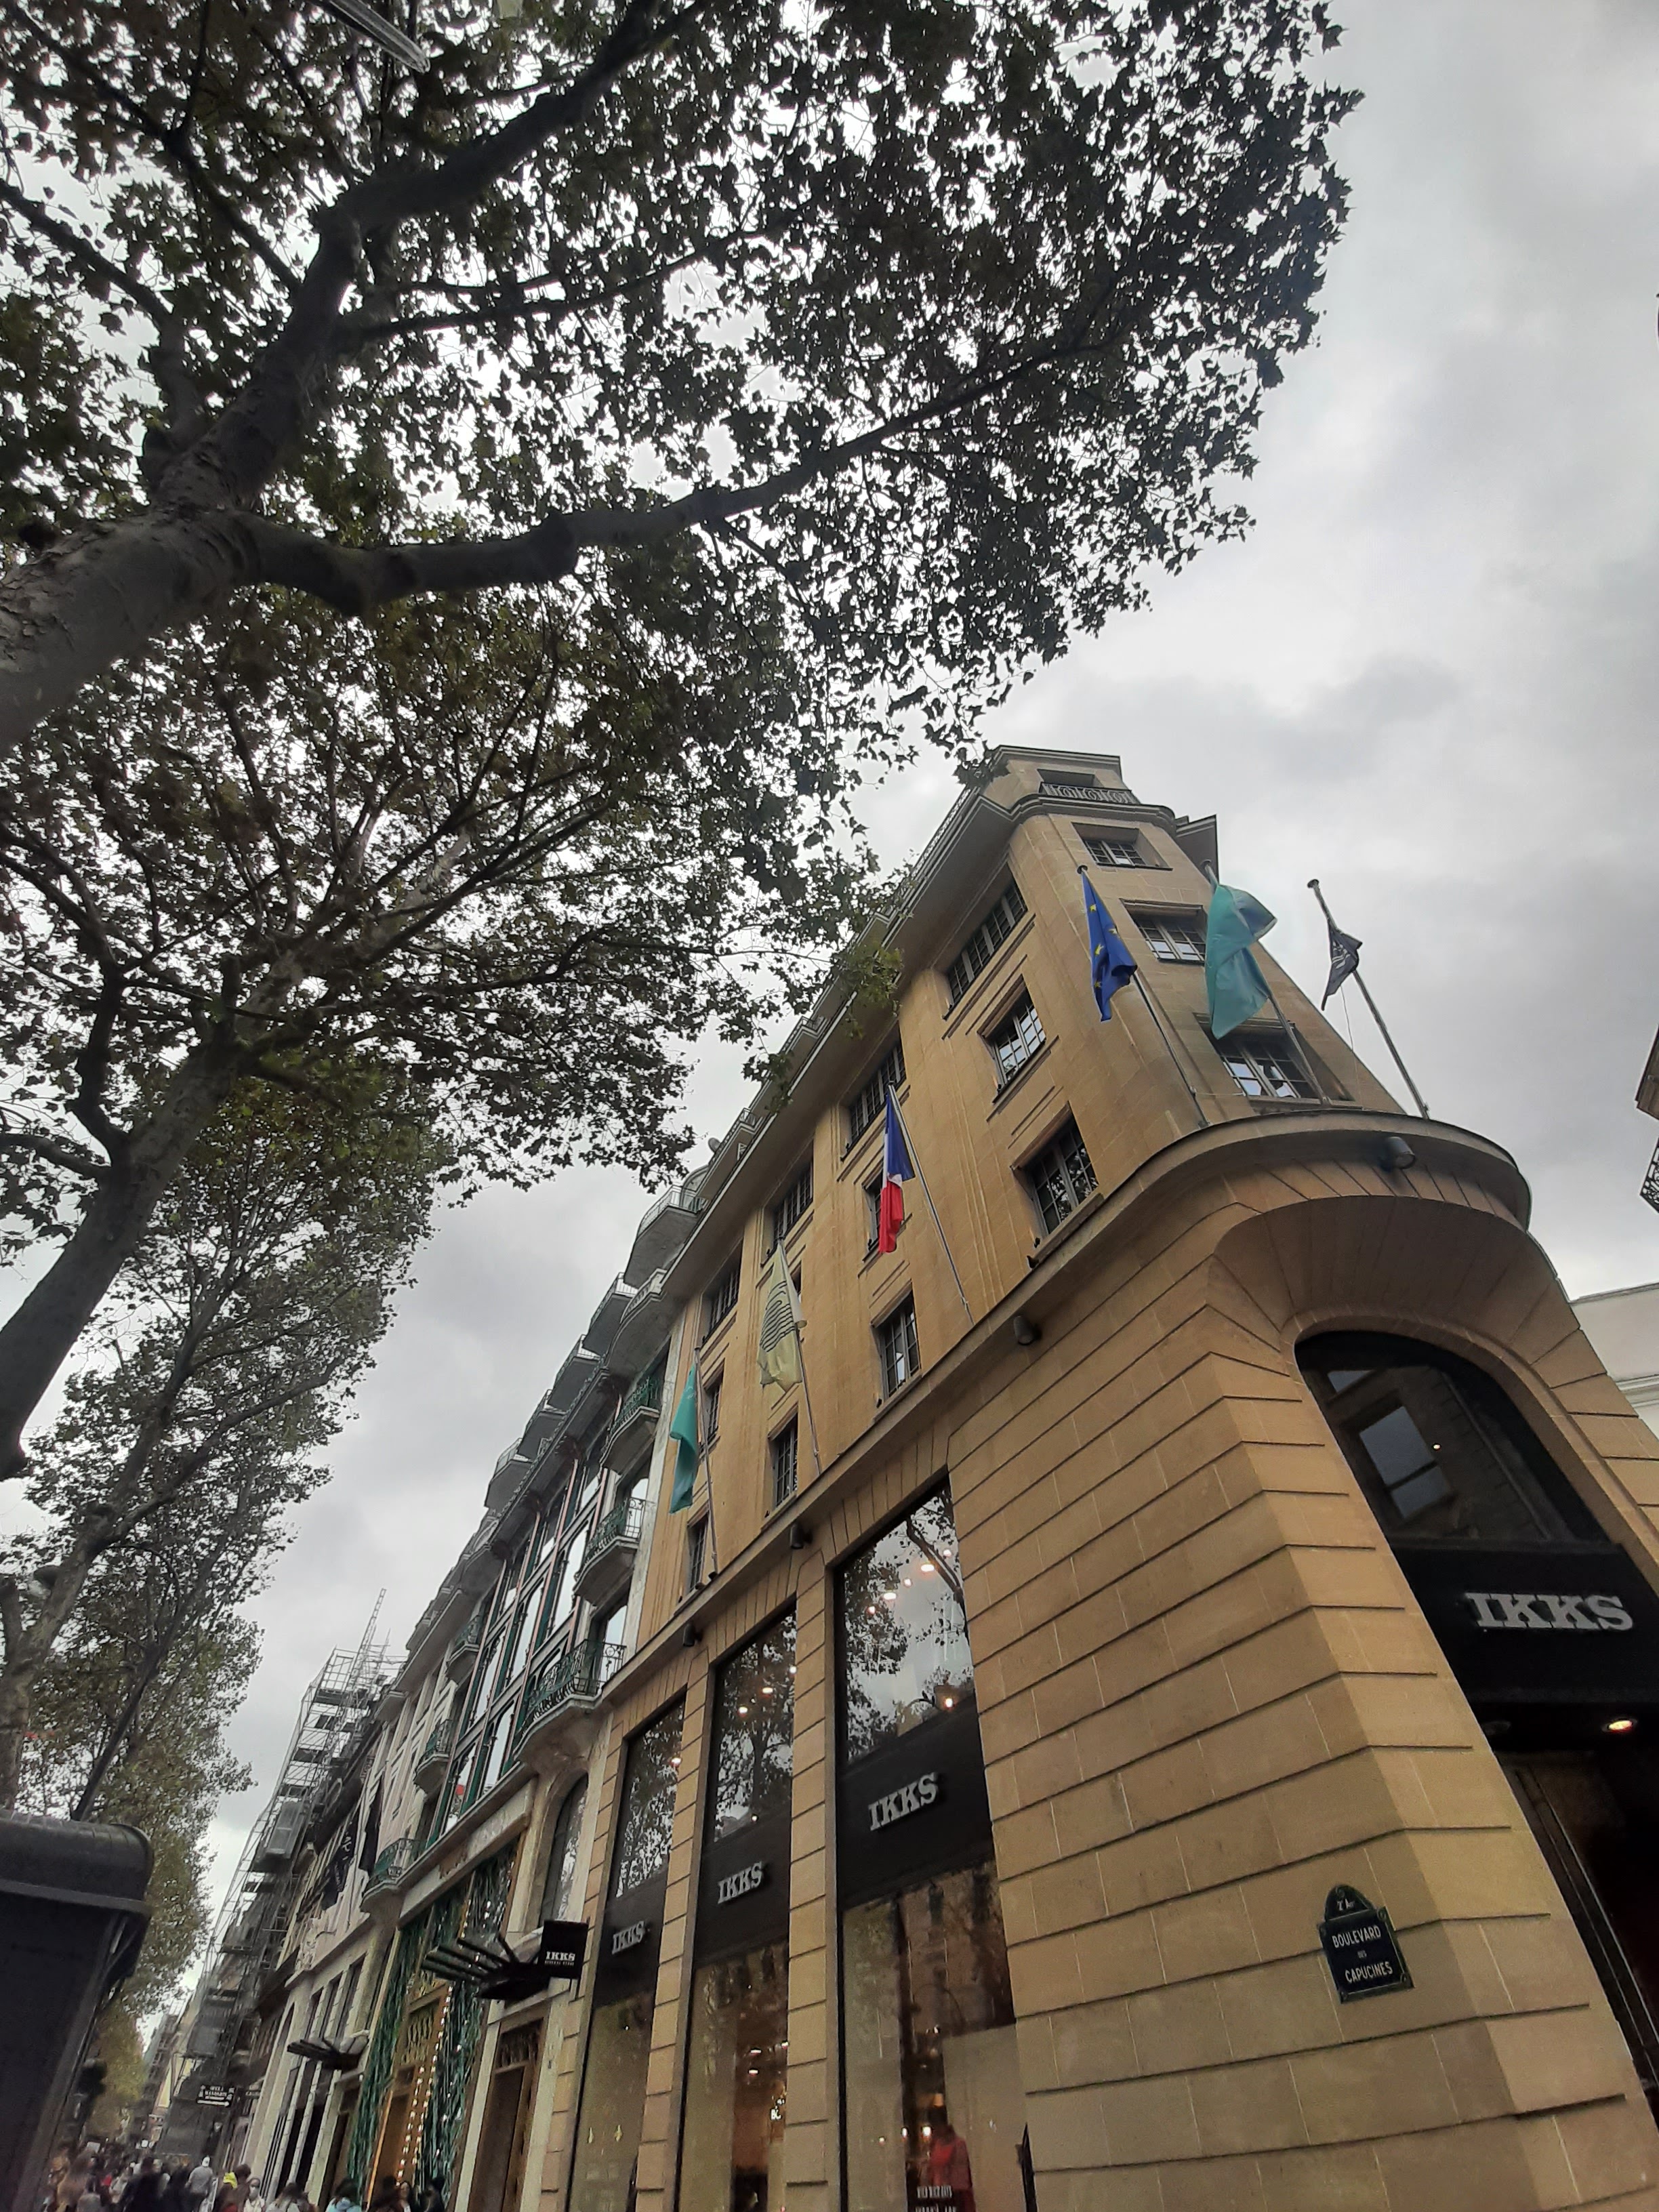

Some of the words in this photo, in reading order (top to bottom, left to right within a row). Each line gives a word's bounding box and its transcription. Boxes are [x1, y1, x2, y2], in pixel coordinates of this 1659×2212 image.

[1465, 1593, 1633, 1631] IKKS
[868, 1772, 939, 1830] IKKS
[717, 1861, 763, 1904] IKKS
[612, 1921, 644, 1954] IKKS
[1332, 1925, 1381, 1948] BOULEVARD
[546, 1951, 576, 1961] IKKS
[1345, 1961, 1393, 1984] CAPUCINES
